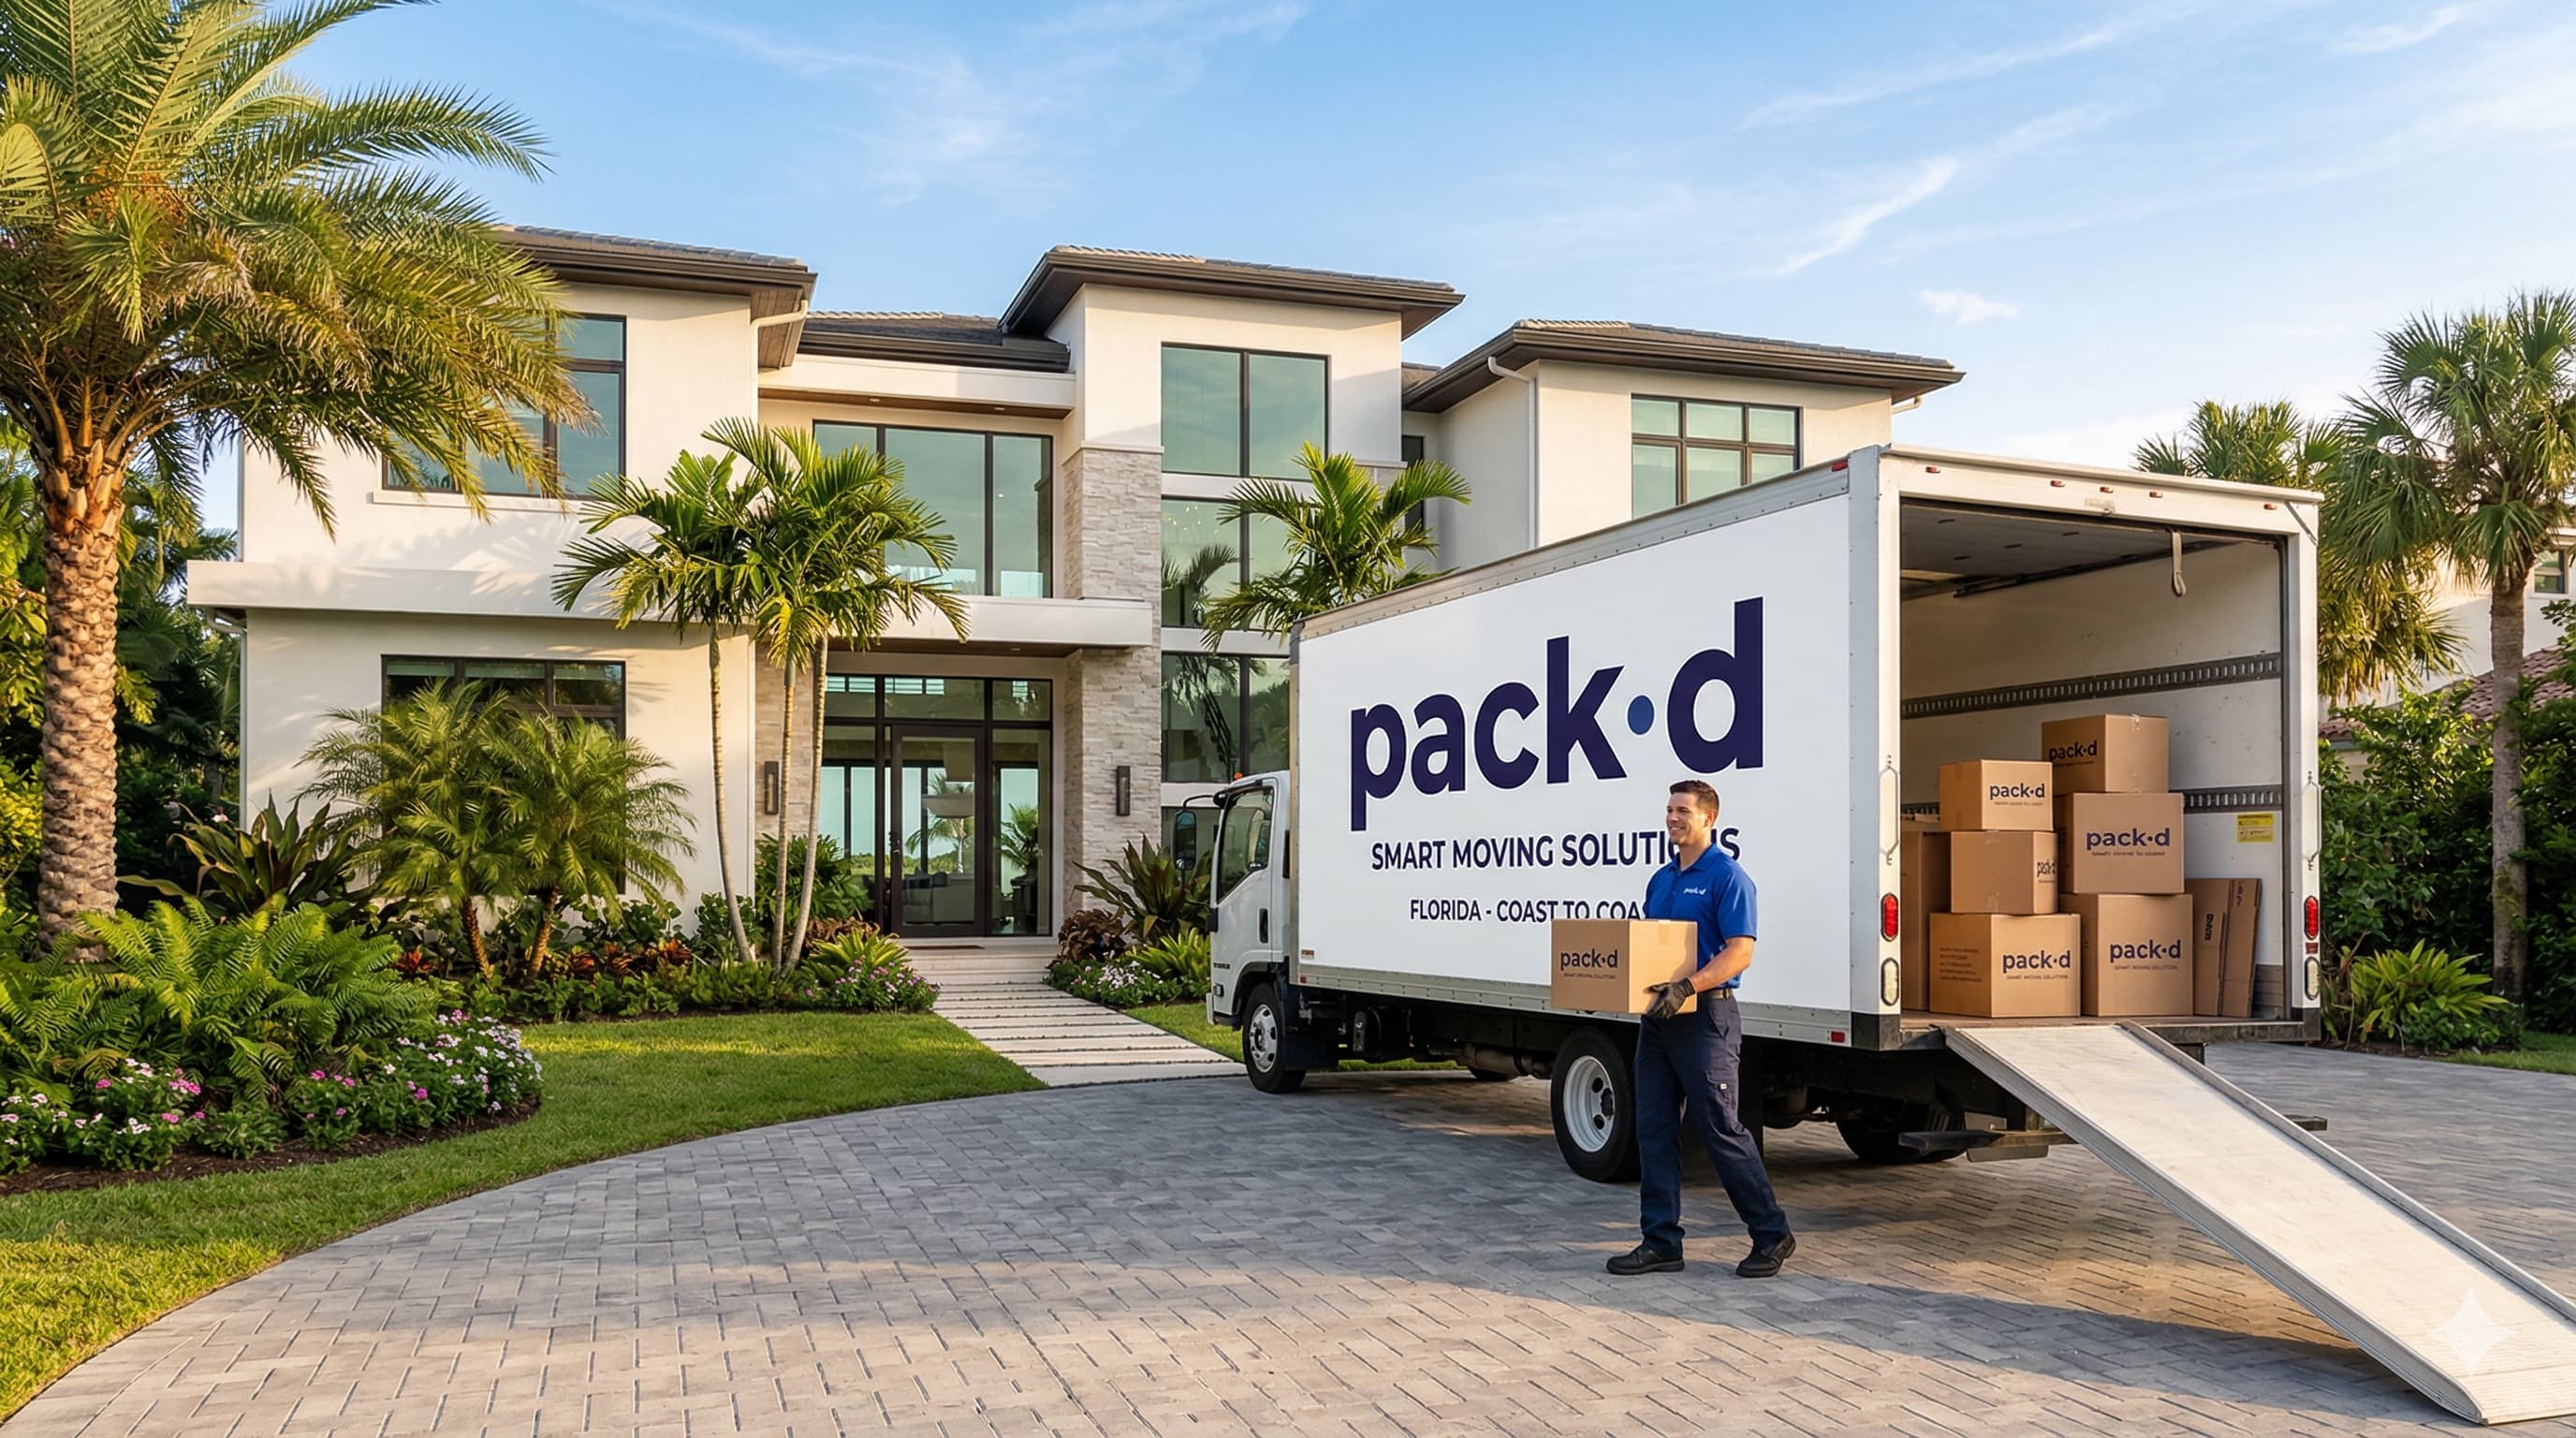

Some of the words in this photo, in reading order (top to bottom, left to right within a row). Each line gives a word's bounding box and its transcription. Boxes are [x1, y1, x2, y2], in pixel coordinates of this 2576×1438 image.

[1371, 840, 1446, 871] SMART
[1453, 835, 1554, 869] MOVING
[1561, 828, 1740, 867] SOLUTIS
[1411, 899, 1482, 921] FLORIDA
[1497, 900, 1559, 922] COAST
[1562, 900, 1590, 919] TO
[1596, 900, 1647, 920] COA
